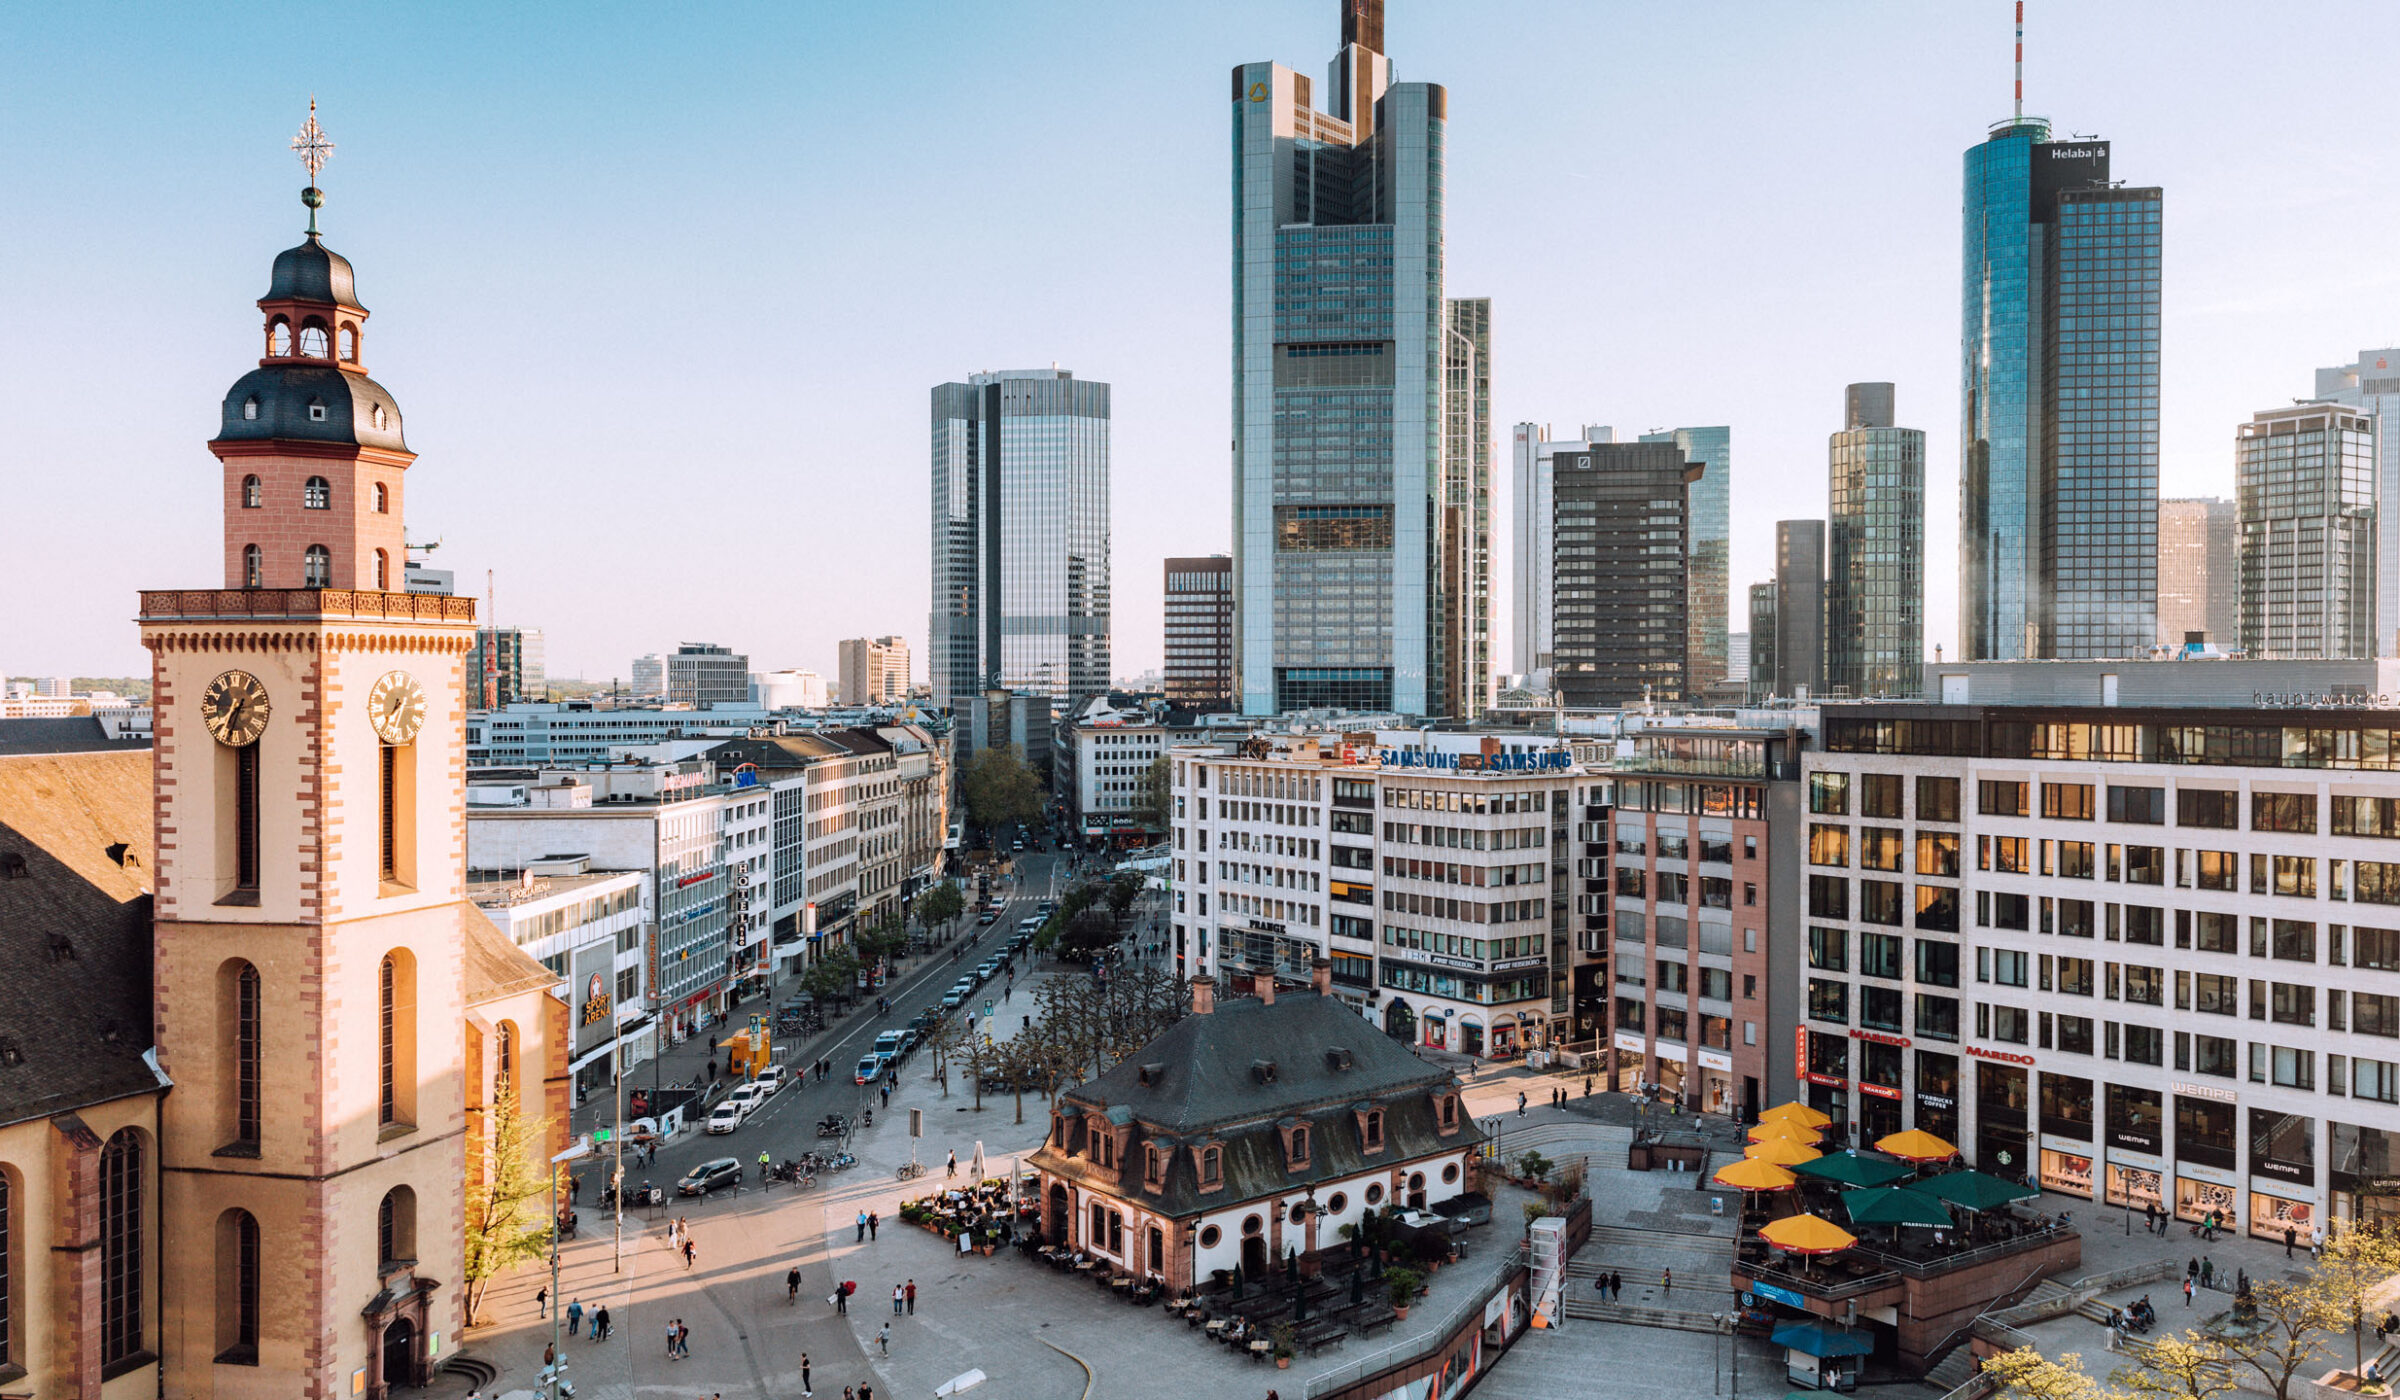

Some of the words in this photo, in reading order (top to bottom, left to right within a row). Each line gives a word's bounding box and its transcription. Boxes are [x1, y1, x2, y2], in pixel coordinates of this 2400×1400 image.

[2052, 149, 2092, 160] Helaba
[2253, 689, 2390, 708] hauptwache
[1380, 750, 1459, 769] SAMSUNG
[1490, 751, 1571, 771] SAMSUNG
[738, 864, 748, 923] HOTEL
[586, 993, 611, 1014] SPORT
[585, 1006, 611, 1027] ARENA
[1849, 1029, 1912, 1048] MAREDO
[1965, 1046, 2035, 1065] MAREDO
[1917, 1093, 1953, 1105] STARBUCKS
[2172, 1081, 2236, 1101] WEMPE
[1924, 1100, 1947, 1109] COFFEE
